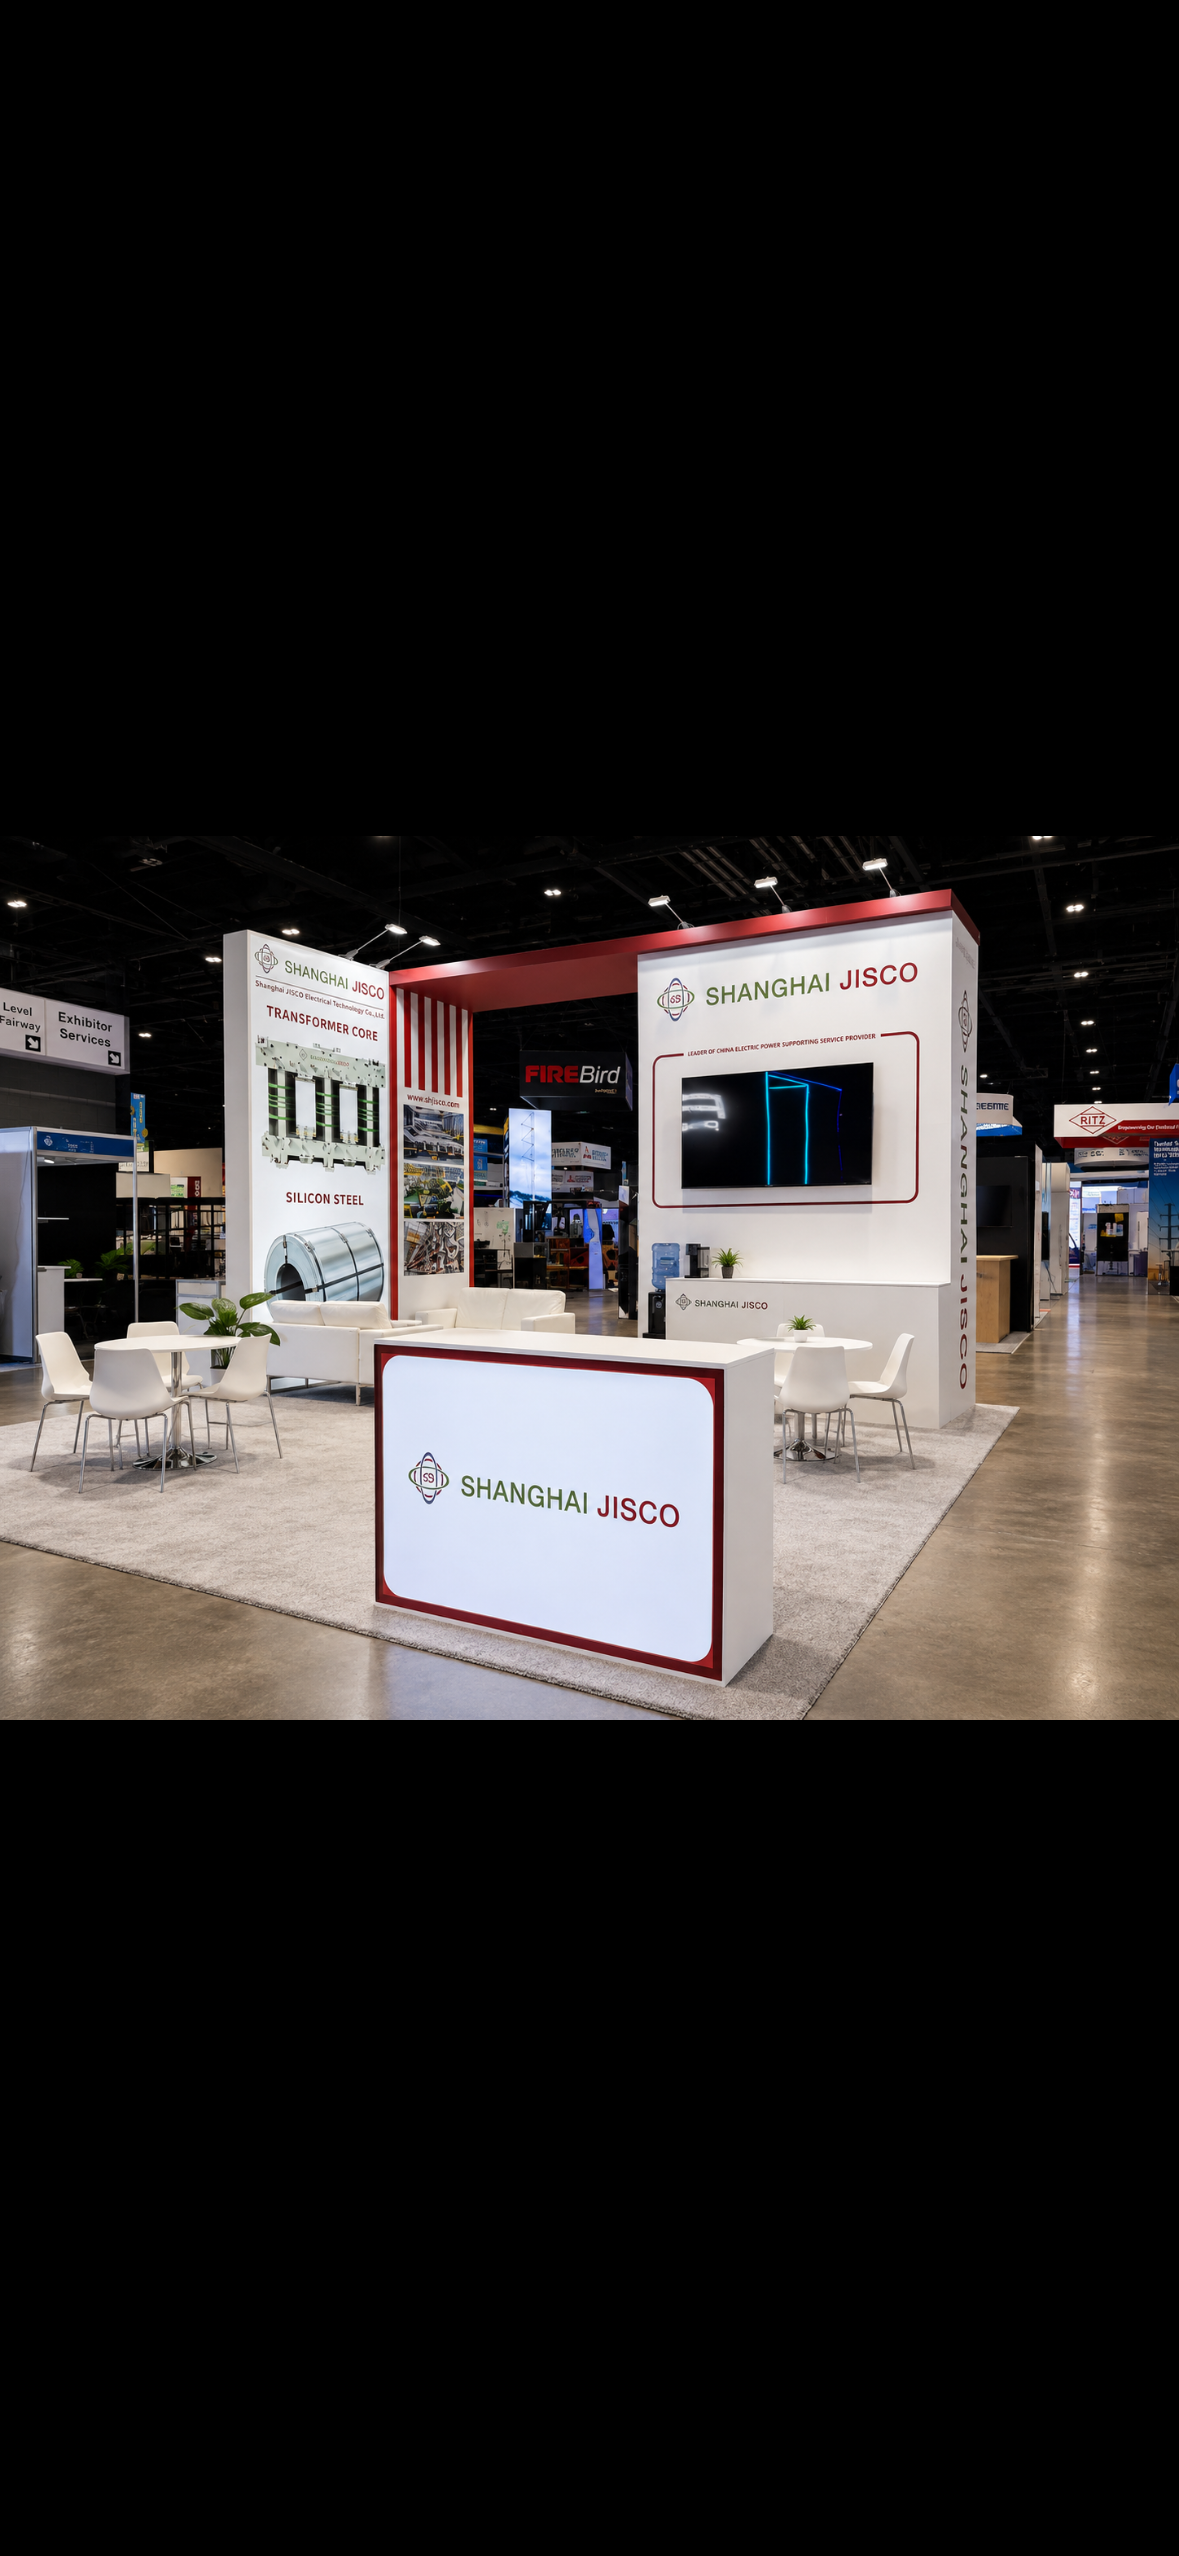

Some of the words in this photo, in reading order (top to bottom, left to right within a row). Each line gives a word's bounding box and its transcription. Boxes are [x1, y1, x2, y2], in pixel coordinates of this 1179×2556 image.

[285, 960, 348, 989] SHANGHAI
[352, 981, 385, 1000] JISCO
[706, 972, 830, 1006] SHANGHAI
[839, 962, 918, 990] JISCO
[3, 1002, 32, 1016] Level
[255, 980, 285, 993] Shanghai
[286, 988, 304, 998] JISCO
[305, 994, 332, 1005] Electrical
[333, 1000, 364, 1015] Technology
[0, 1014, 41, 1033] Fairway
[58, 1011, 113, 1032] Exhibitor
[266, 1005, 349, 1035] TRANSFORMER
[352, 1026, 378, 1041] CORE
[60, 1028, 111, 1047] Services
[687, 1049, 708, 1057] LEADER
[735, 1044, 759, 1052] ELECTRIC
[782, 1038, 819, 1048] SUPPORTING
[820, 1036, 844, 1044] SERVICE
[845, 1033, 876, 1041] PROVIDER
[1080, 1115, 1106, 1125] RITZ
[960, 1065, 968, 1263] SHANGHAI
[286, 1191, 331, 1204] SILICON
[333, 1193, 364, 1206] STEEL
[694, 1299, 739, 1308] SHANGHAI
[741, 1301, 768, 1310] JISCO
[960, 1274, 968, 1389] JISCO
[461, 1475, 588, 1515] SHANGHAI
[597, 1495, 680, 1528] JISCO
